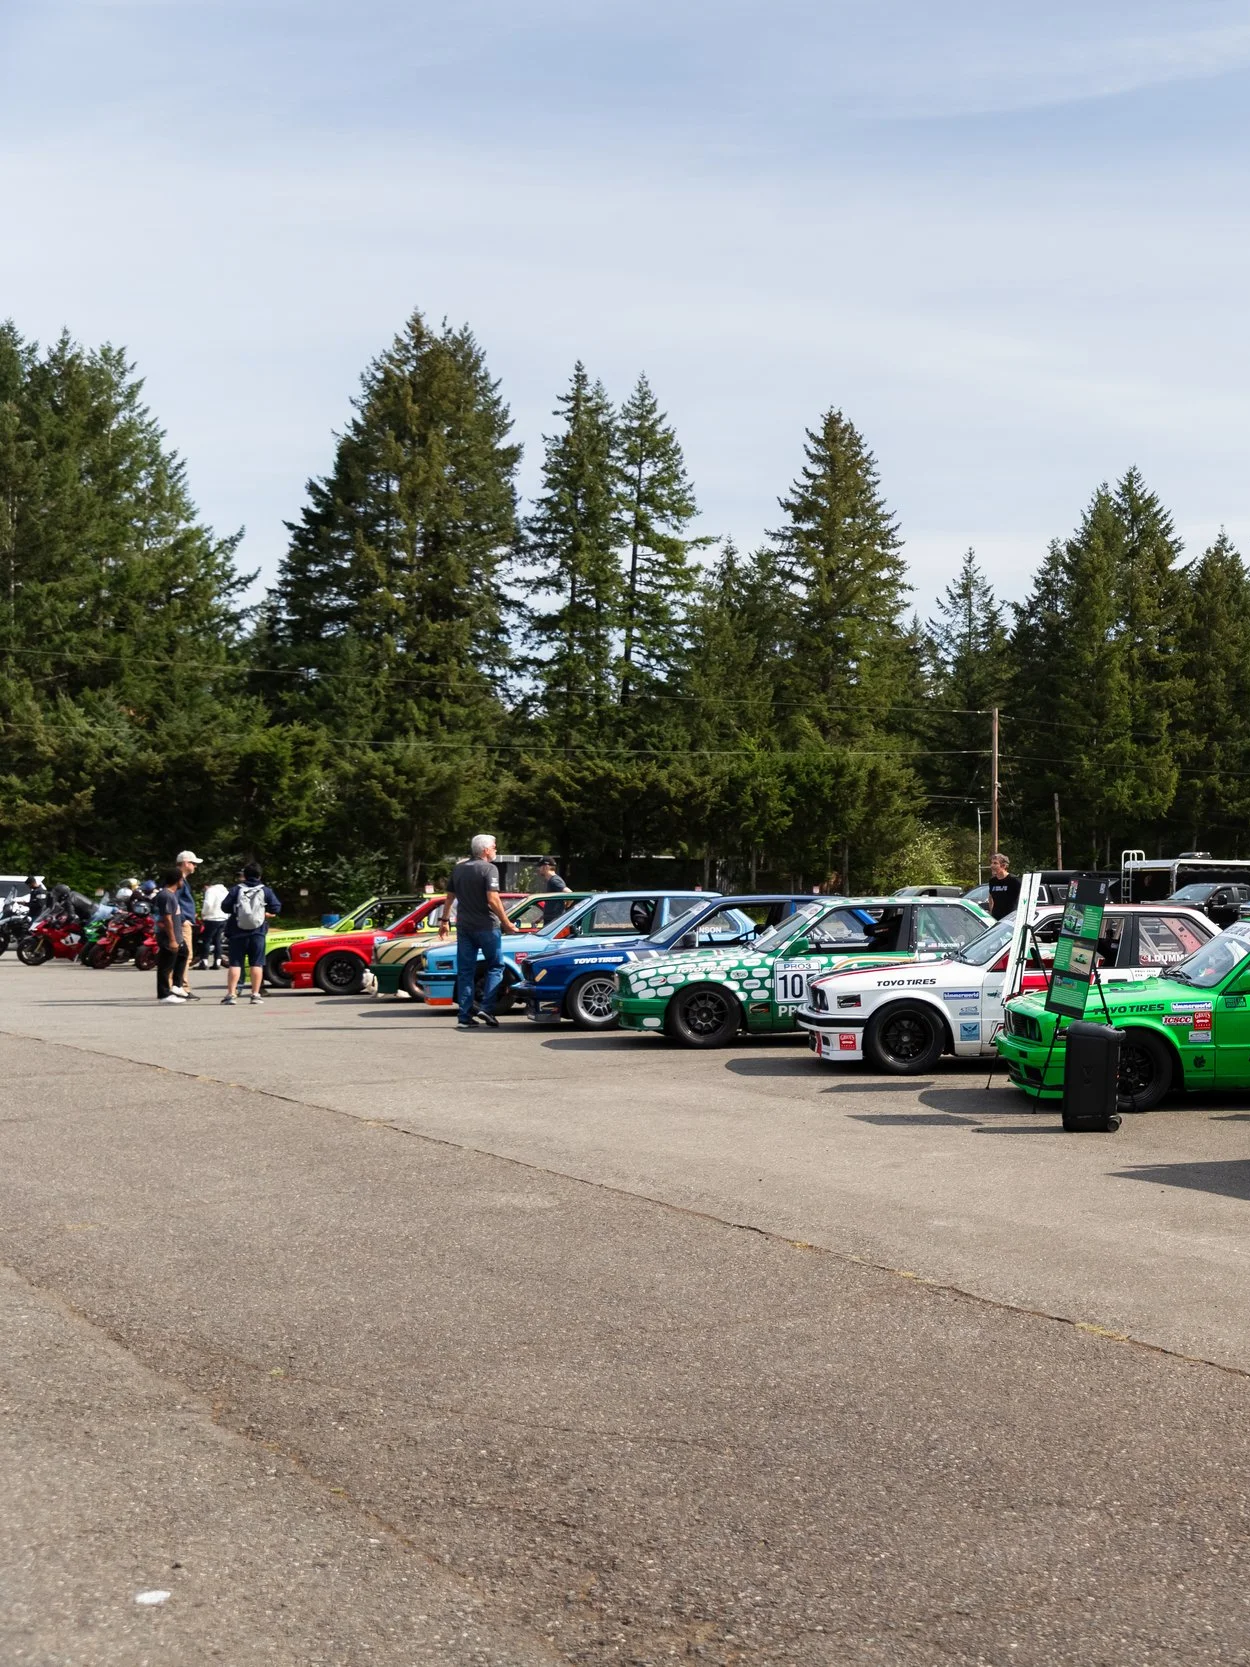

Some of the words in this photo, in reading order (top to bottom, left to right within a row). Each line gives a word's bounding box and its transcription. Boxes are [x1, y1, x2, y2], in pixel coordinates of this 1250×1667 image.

[699, 926, 722, 934] NSON
[573, 957, 598, 965] TOYO
[778, 973, 816, 999] 10
[876, 979, 905, 987] TOYO
[906, 978, 937, 986] TIRES
[1129, 1003, 1165, 1013] TIRES
[1172, 1001, 1213, 1010] bimmerworld
